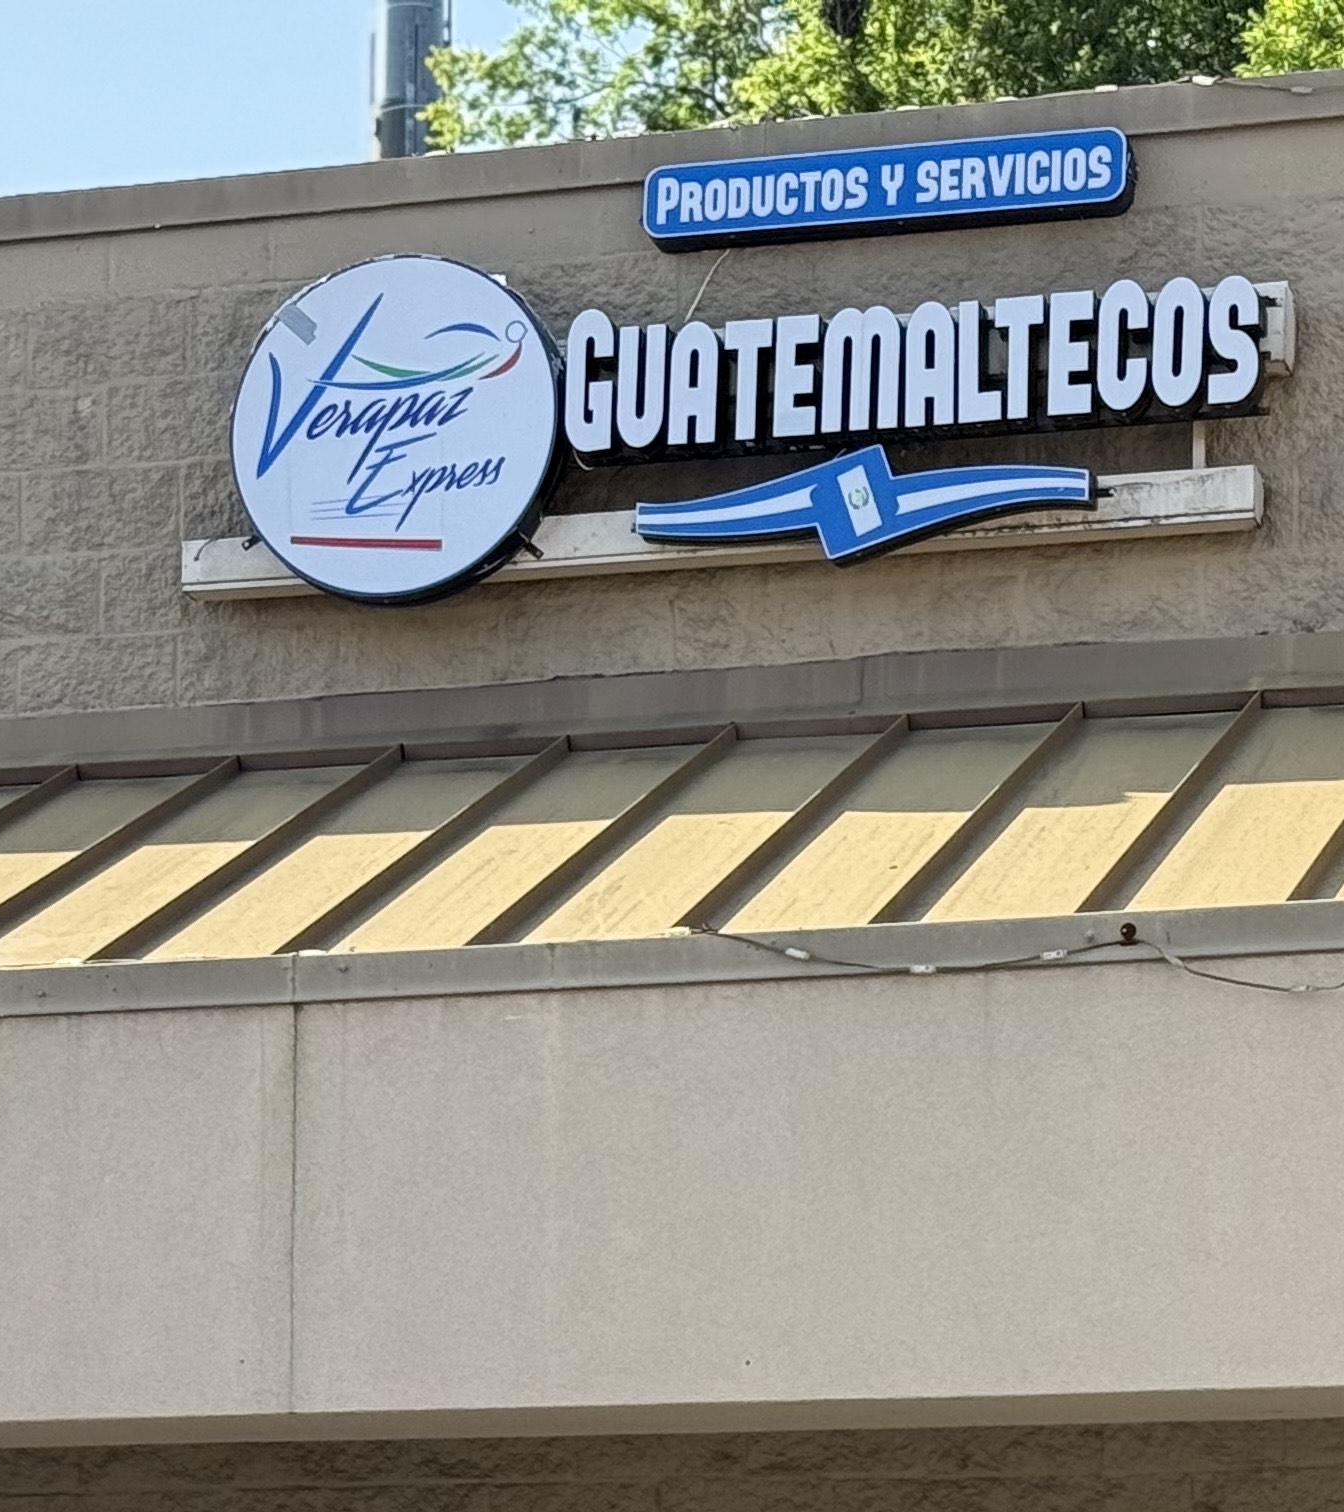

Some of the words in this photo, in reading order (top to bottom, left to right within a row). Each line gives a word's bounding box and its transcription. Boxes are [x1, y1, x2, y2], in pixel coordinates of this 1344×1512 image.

[656, 166, 868, 225] PRODUCTOS
[880, 164, 904, 205] Y
[916, 145, 1112, 202] SERVICIOS
[257, 293, 473, 485] Verapaz
[565, 274, 1260, 452] GUATEMALTECOS
[346, 432, 506, 533] Express
